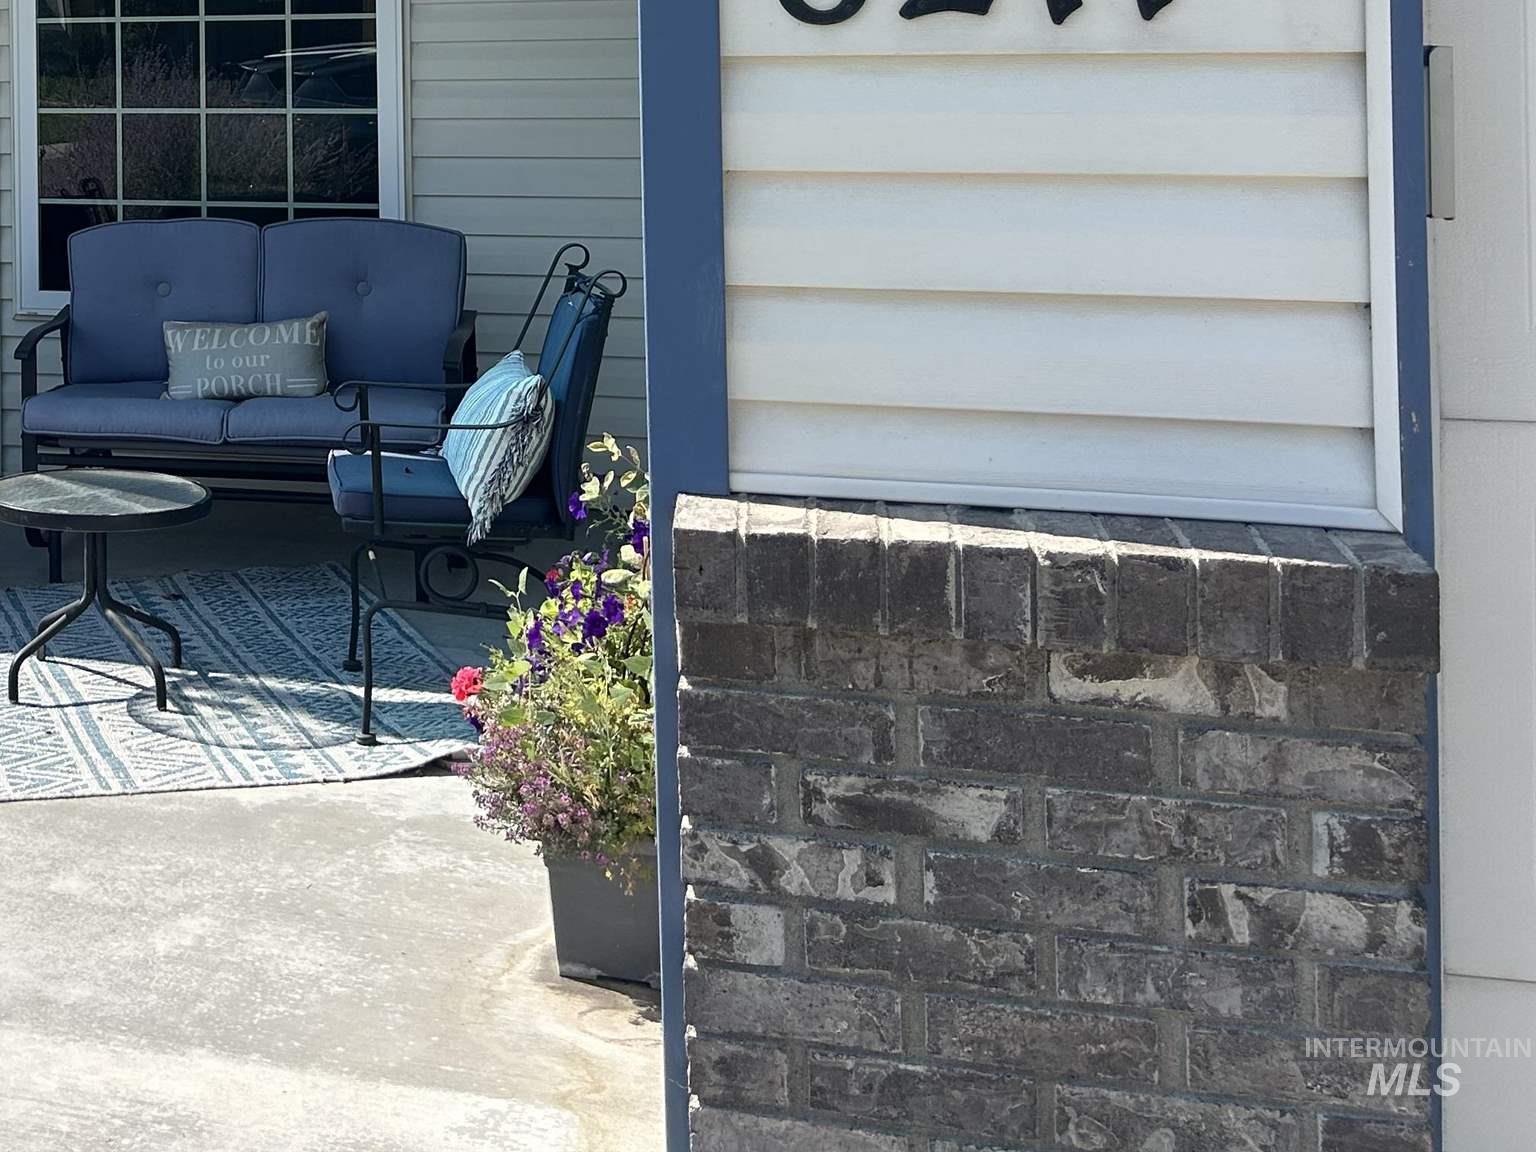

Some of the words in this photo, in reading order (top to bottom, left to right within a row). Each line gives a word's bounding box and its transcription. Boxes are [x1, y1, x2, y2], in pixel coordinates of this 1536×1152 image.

[166, 320, 321, 353] WELCOME
[206, 354, 225, 371] to
[231, 353, 271, 368] our
[196, 372, 282, 398] PORCH
